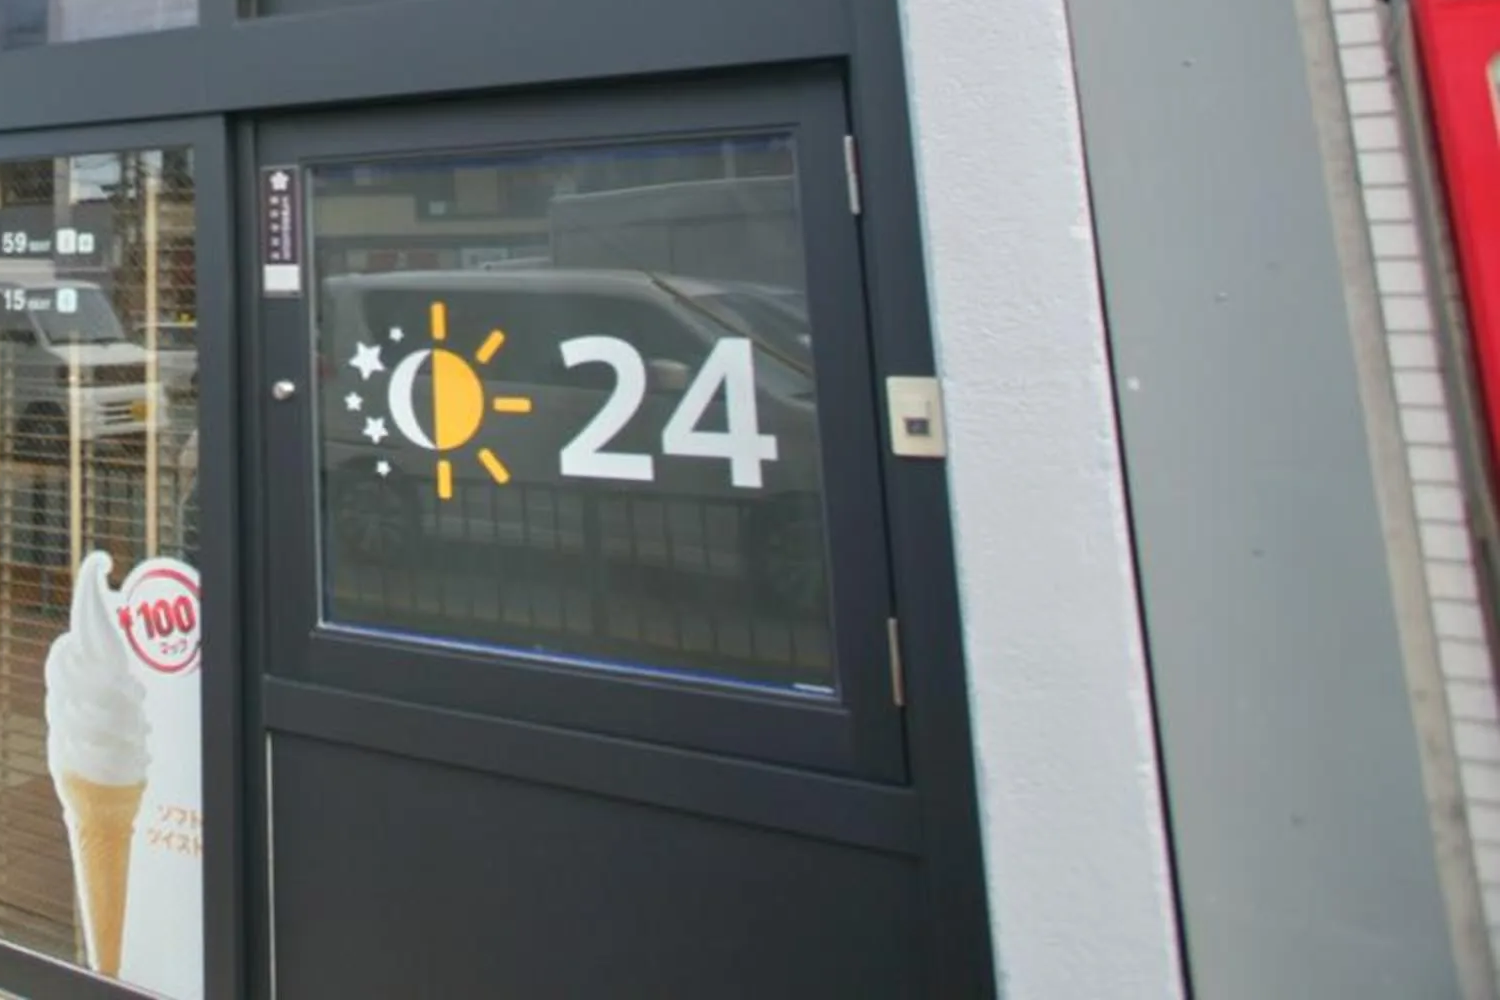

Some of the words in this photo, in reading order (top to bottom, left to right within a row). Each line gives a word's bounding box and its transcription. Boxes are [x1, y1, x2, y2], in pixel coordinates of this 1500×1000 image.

[2, 231, 27, 254] 59
[3, 288, 26, 310] 15
[558, 335, 779, 488] 24
